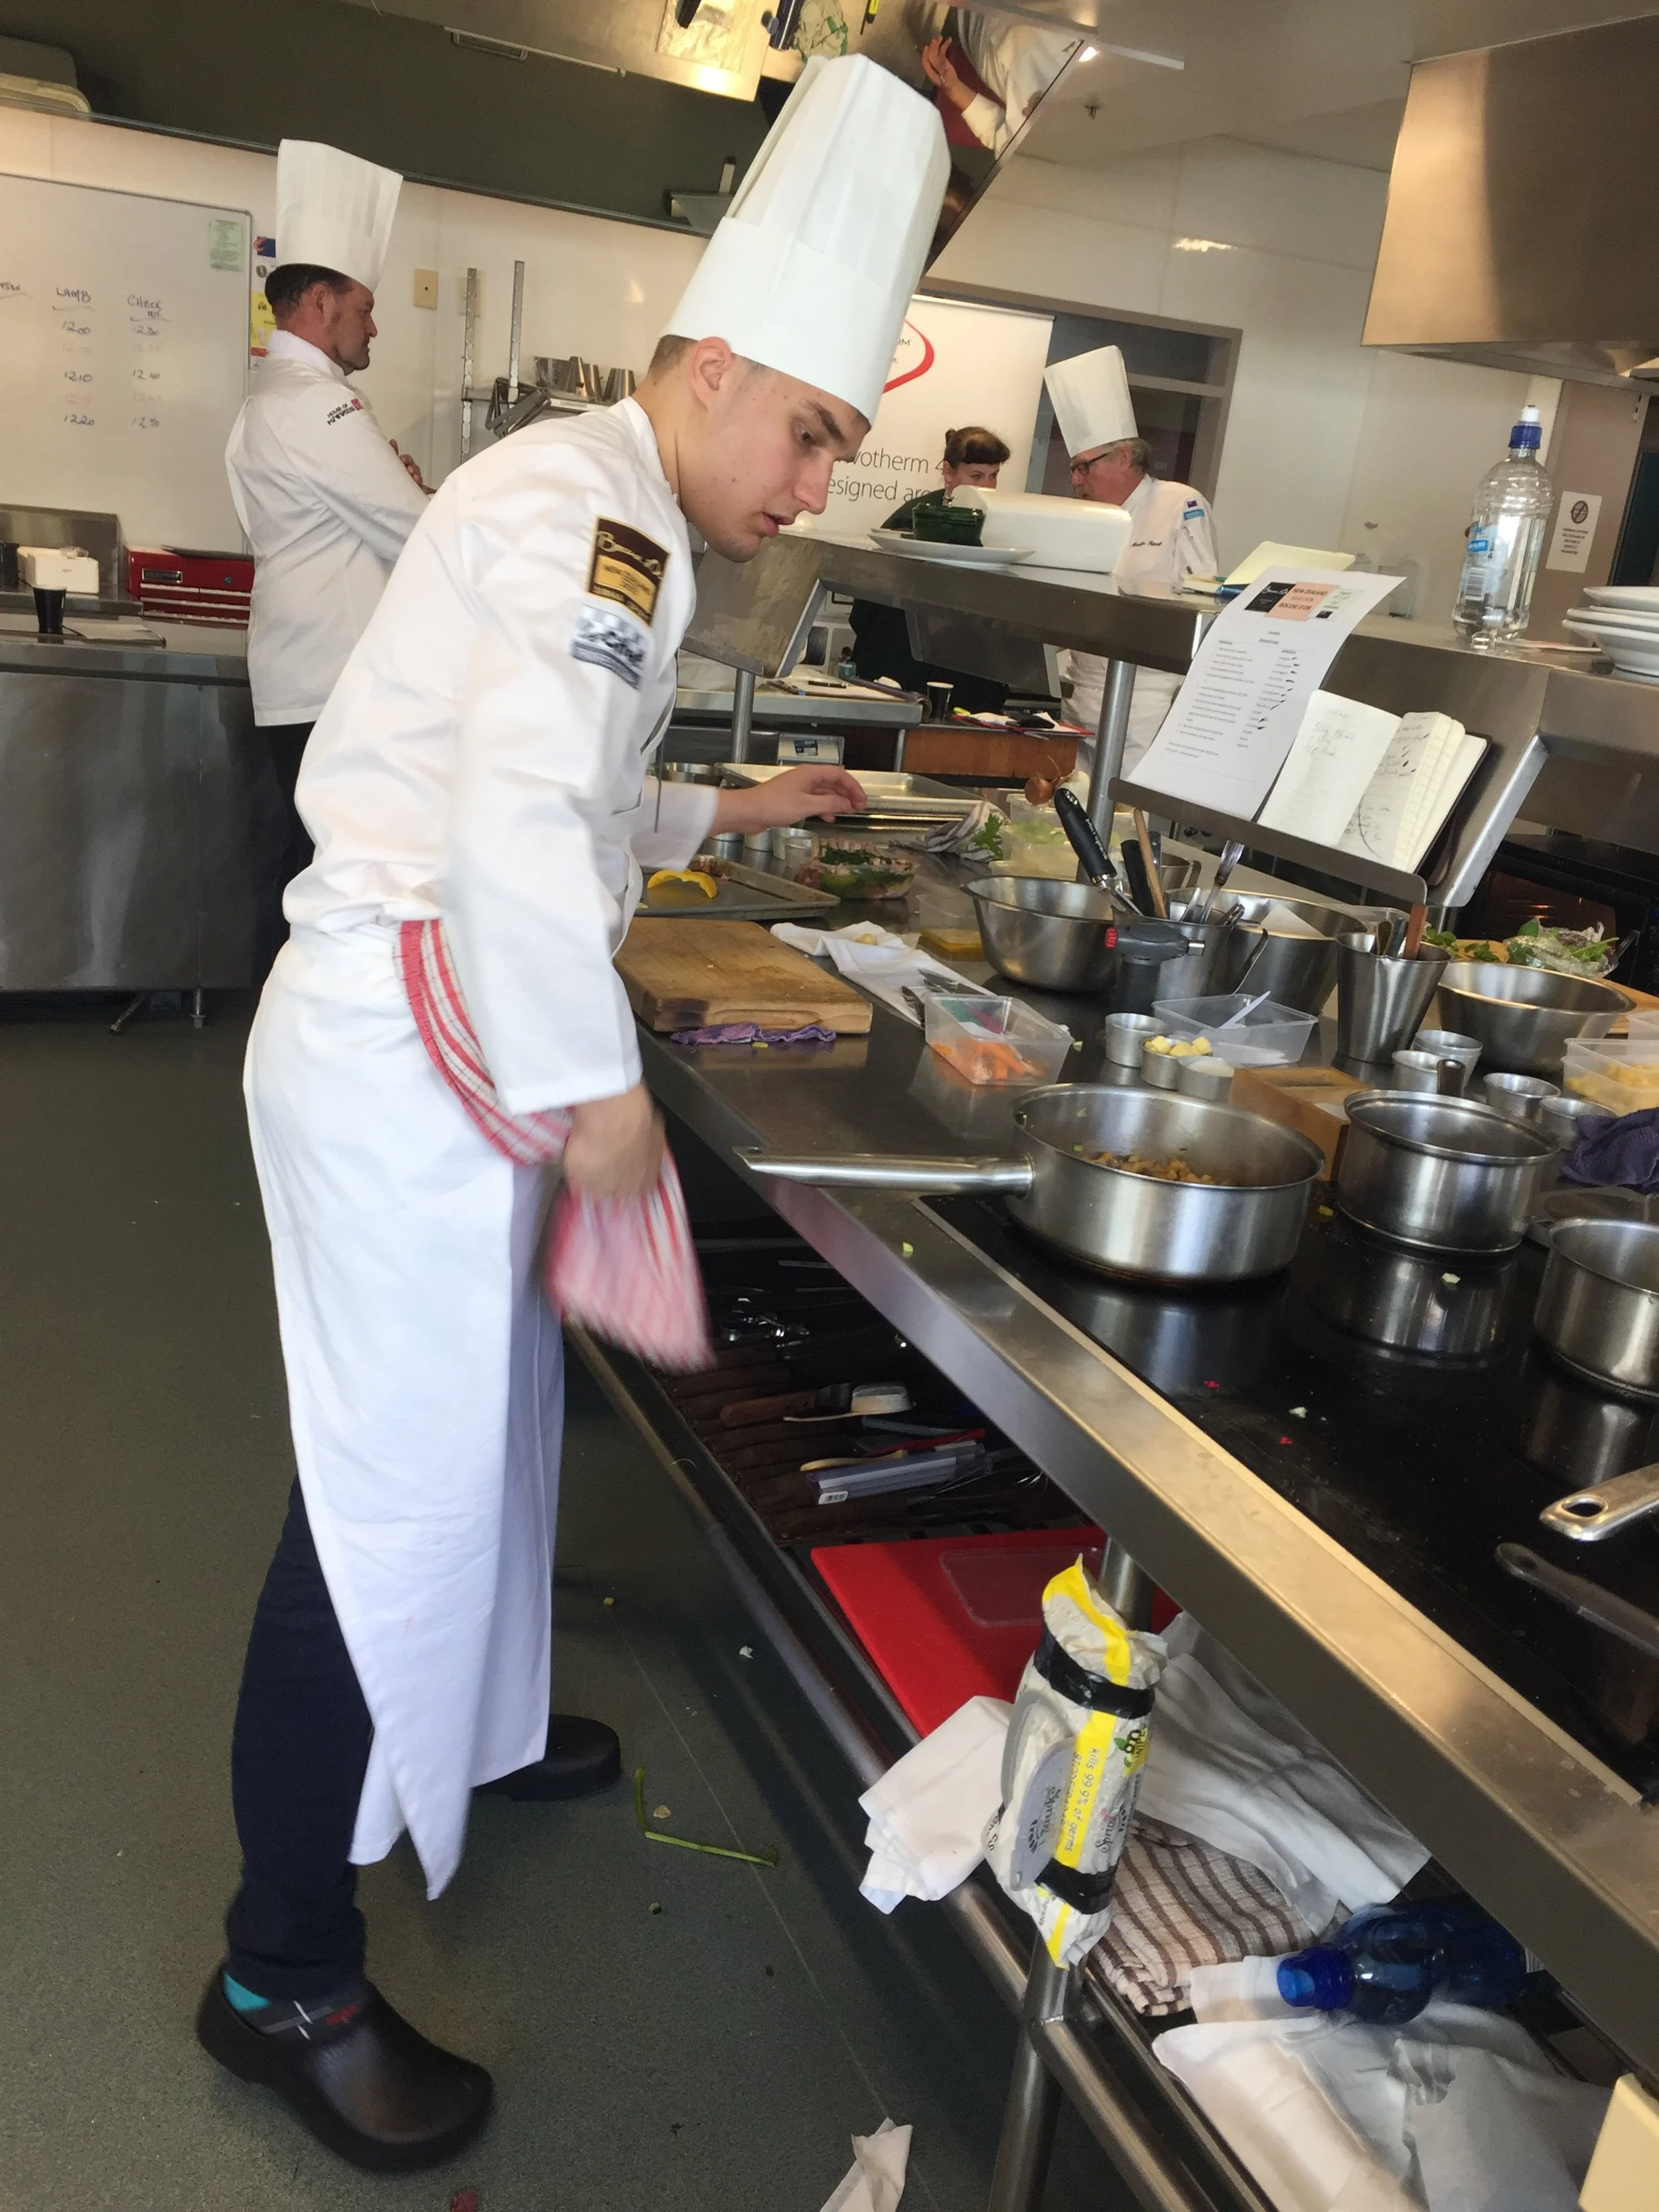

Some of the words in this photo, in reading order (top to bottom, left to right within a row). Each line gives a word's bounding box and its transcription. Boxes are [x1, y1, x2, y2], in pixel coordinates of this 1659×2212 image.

[56, 287, 91, 303] LAMB
[828, 476, 899, 502] esigned
[1074, 1807, 1083, 1822] of
[1064, 1820, 1078, 1852] germs
